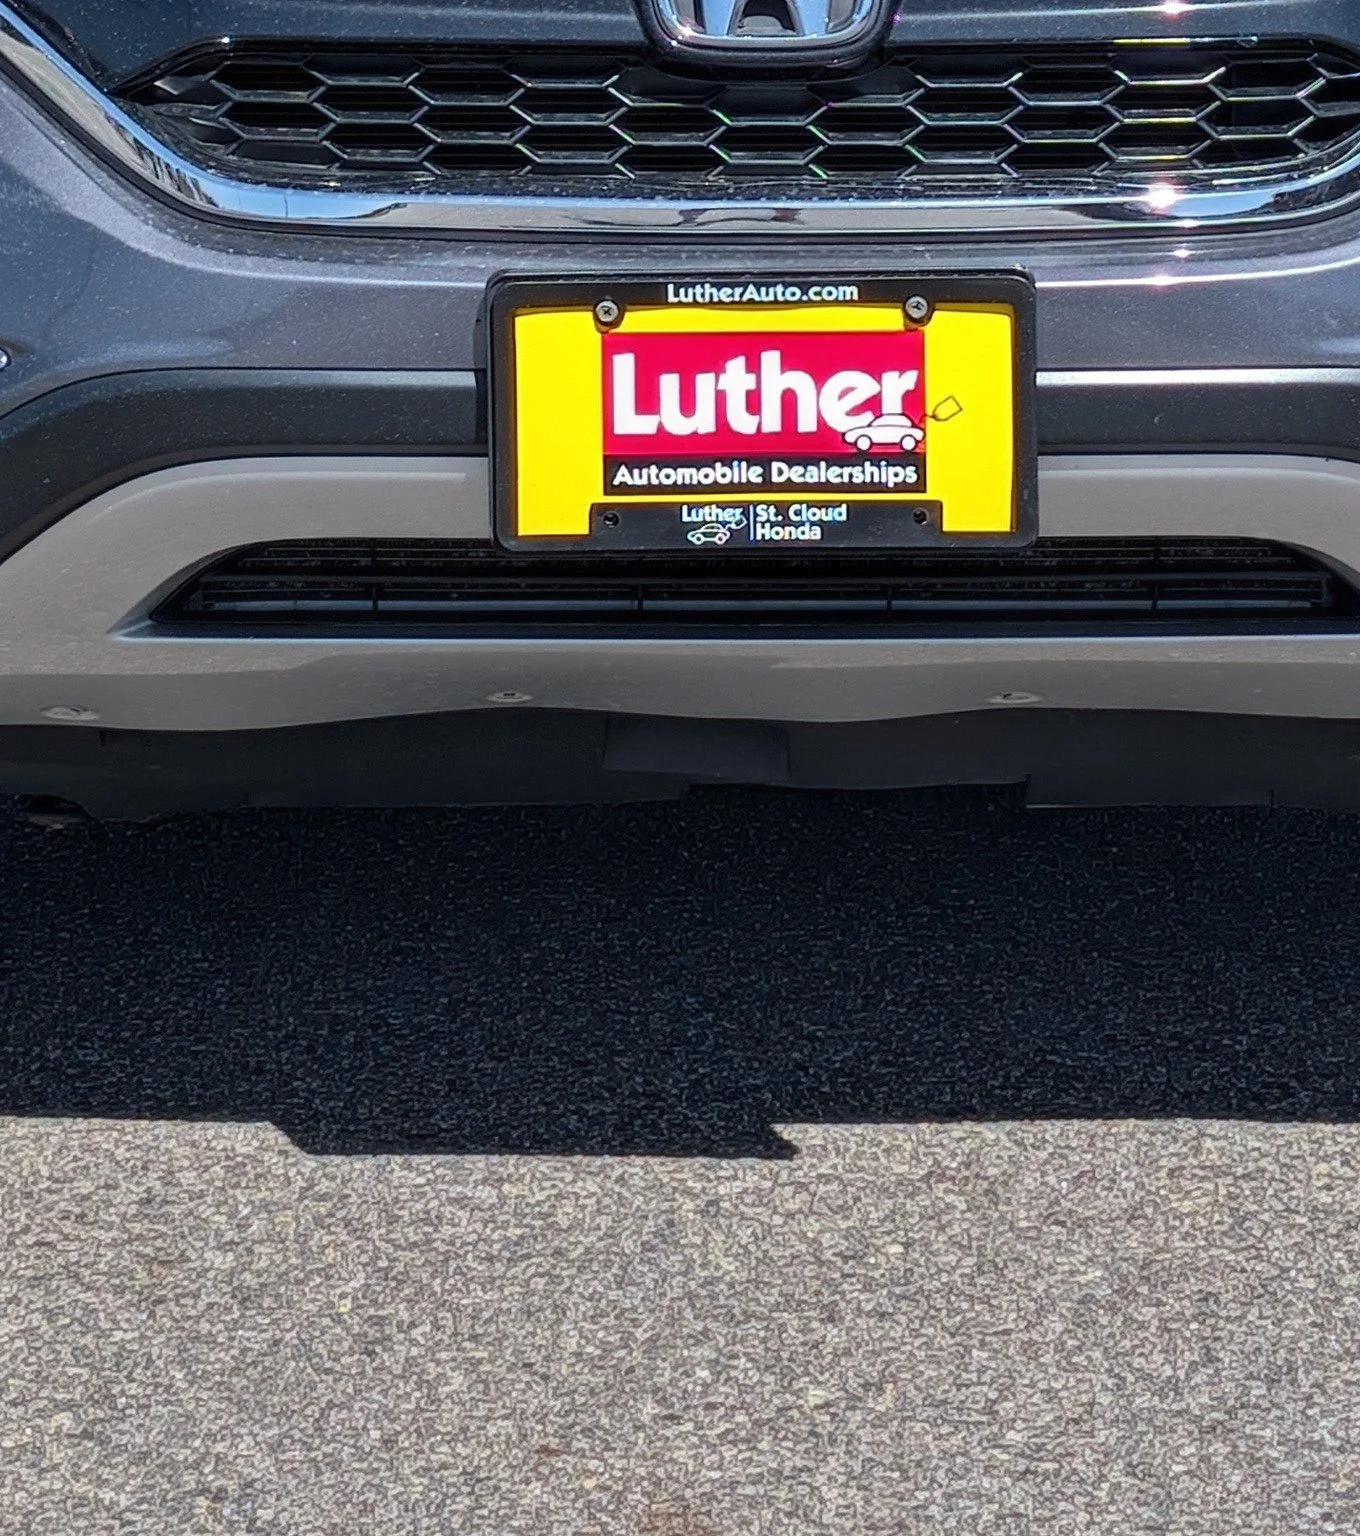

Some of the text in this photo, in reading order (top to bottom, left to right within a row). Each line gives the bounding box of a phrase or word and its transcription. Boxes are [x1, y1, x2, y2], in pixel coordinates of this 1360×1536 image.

[666, 282, 860, 304] LutherAuto.com
[612, 349, 919, 436] Luther
[612, 460, 919, 489] Automobile Dealerships
[681, 504, 744, 523] Luther
[755, 503, 848, 522] St. Cloud
[755, 522, 823, 541] Honda
